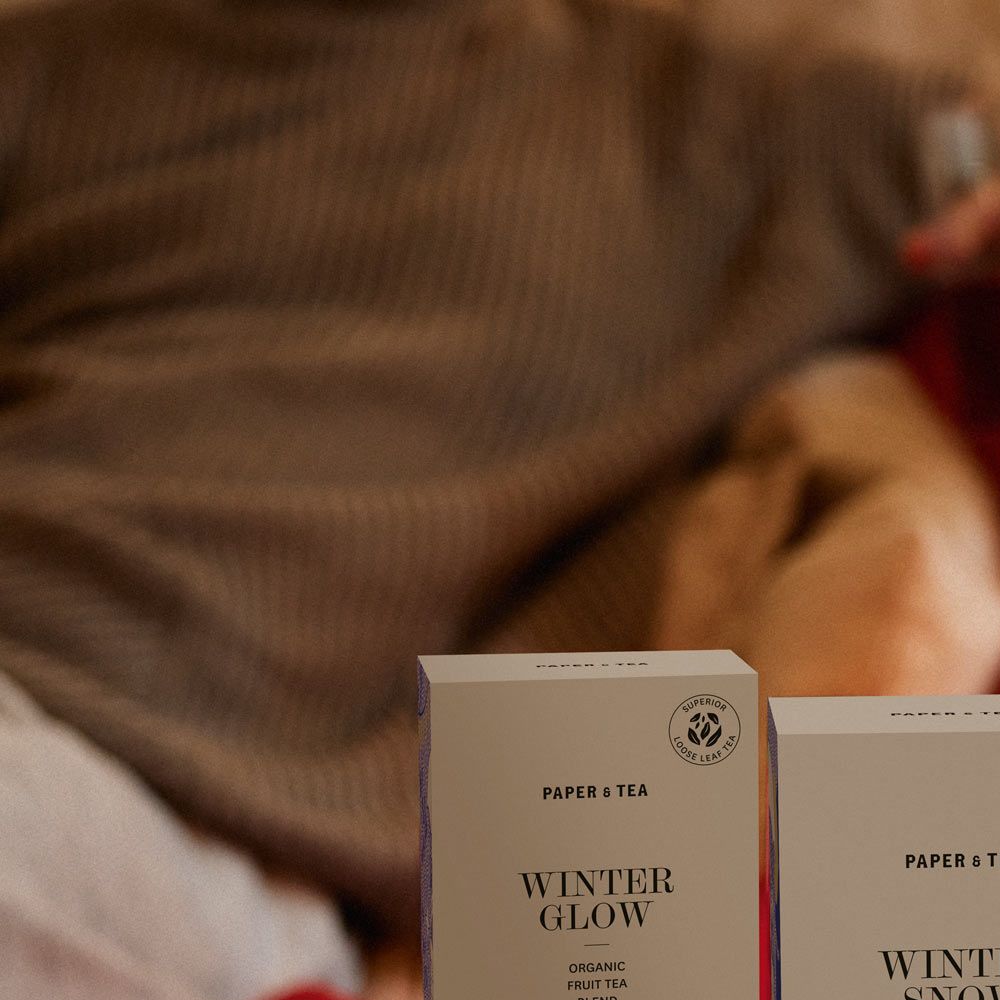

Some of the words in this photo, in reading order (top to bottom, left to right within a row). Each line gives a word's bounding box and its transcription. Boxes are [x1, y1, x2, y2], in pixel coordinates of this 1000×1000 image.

[682, 698, 727, 713] SUPERIOR
[673, 736, 697, 761] LOOSE
[700, 751, 722, 762] LEAF
[722, 734, 736, 752] TEA
[543, 785, 597, 800] PAPER
[603, 786, 611, 798] &
[616, 784, 648, 797] TEA
[906, 853, 965, 868] PAPER
[972, 855, 981, 867] &
[518, 867, 674, 899] WINTER
[540, 900, 654, 931] GLOW
[568, 961, 626, 974] ORGANIC
[568, 980, 602, 991] FRUIT
[605, 979, 627, 989] TEA
